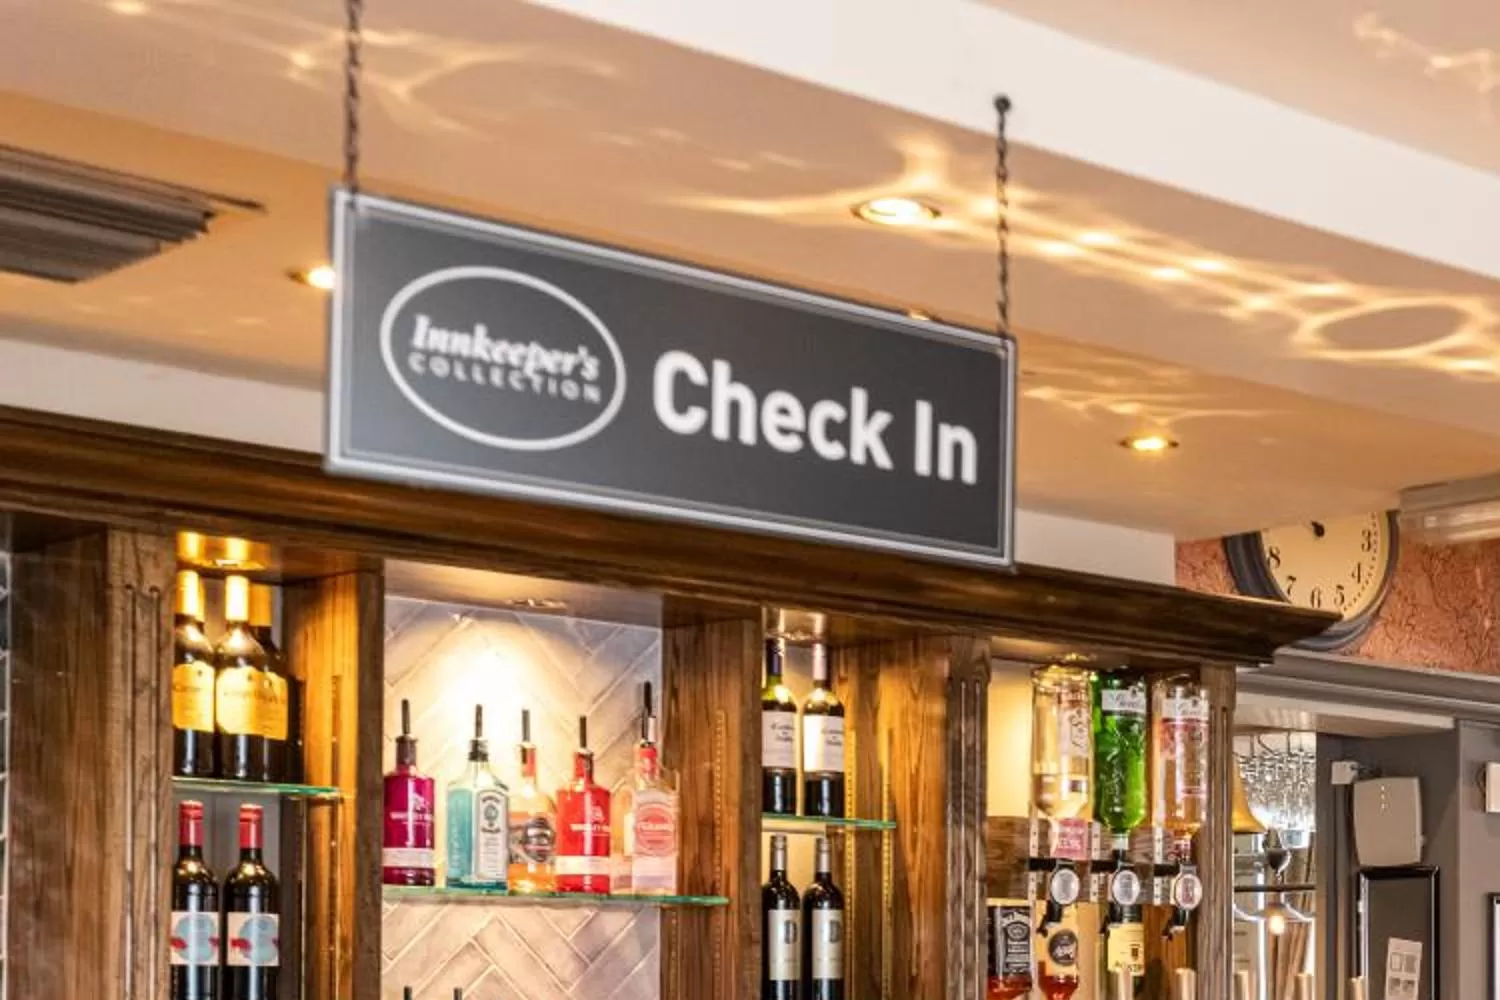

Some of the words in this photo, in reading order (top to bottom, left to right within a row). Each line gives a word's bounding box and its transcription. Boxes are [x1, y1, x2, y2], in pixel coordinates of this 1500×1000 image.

[410, 313, 600, 381] Innkeeper's
[407, 351, 602, 404] COLLECTION
[652, 350, 894, 470] Check
[914, 399, 978, 485] In
[1361, 528, 1372, 552] 3
[1267, 546, 1281, 568] 8
[1351, 561, 1362, 584] 4
[1285, 575, 1297, 596] 7
[1334, 584, 1345, 606] 5
